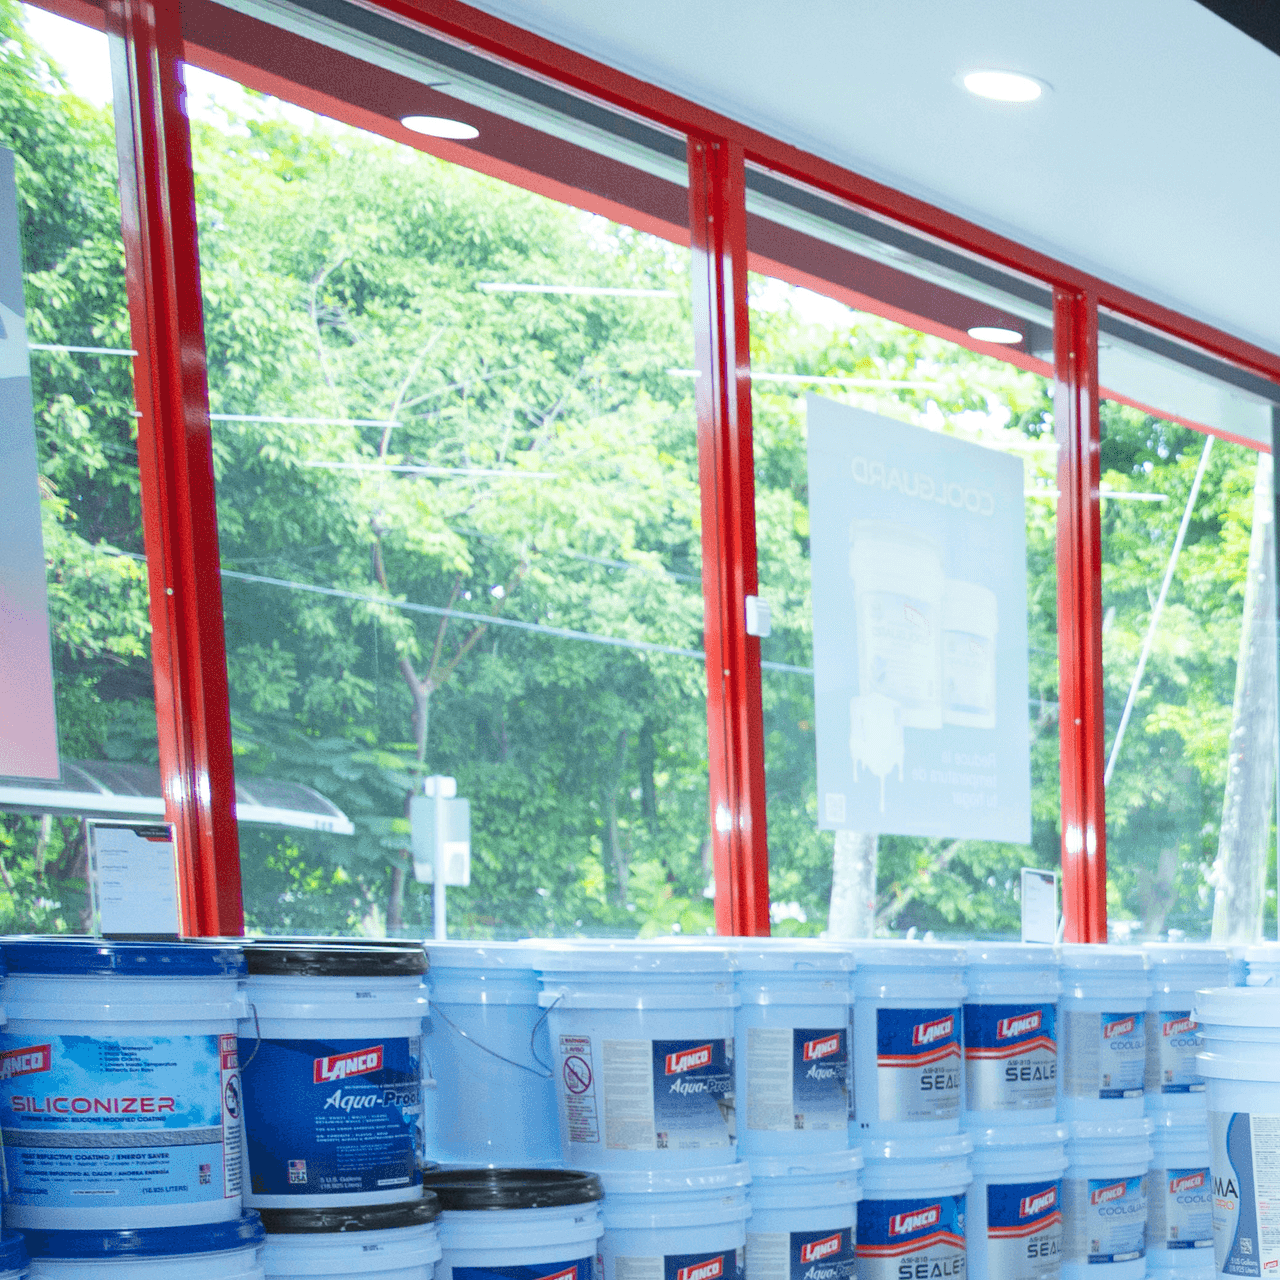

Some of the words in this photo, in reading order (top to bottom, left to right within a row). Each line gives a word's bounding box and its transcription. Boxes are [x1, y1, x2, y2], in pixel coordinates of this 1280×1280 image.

[919, 1021, 950, 1043] LANCO
[1003, 1016, 1038, 1037] LANCO
[1107, 1020, 1132, 1038] LANCO
[808, 1038, 837, 1059] LANCO
[1, 1051, 44, 1079] ANCO
[322, 1053, 378, 1082] LANCO
[671, 1048, 709, 1074] LANCO
[12, 1095, 175, 1114] SILICONIZER
[324, 1089, 419, 1113] Aqua-Proo
[1094, 1186, 1124, 1204] LANCO
[1173, 1175, 1201, 1193] LANCO
[1025, 1192, 1054, 1215] LANCO
[895, 1211, 936, 1233] LANCO
[805, 1238, 838, 1260] LANCO
